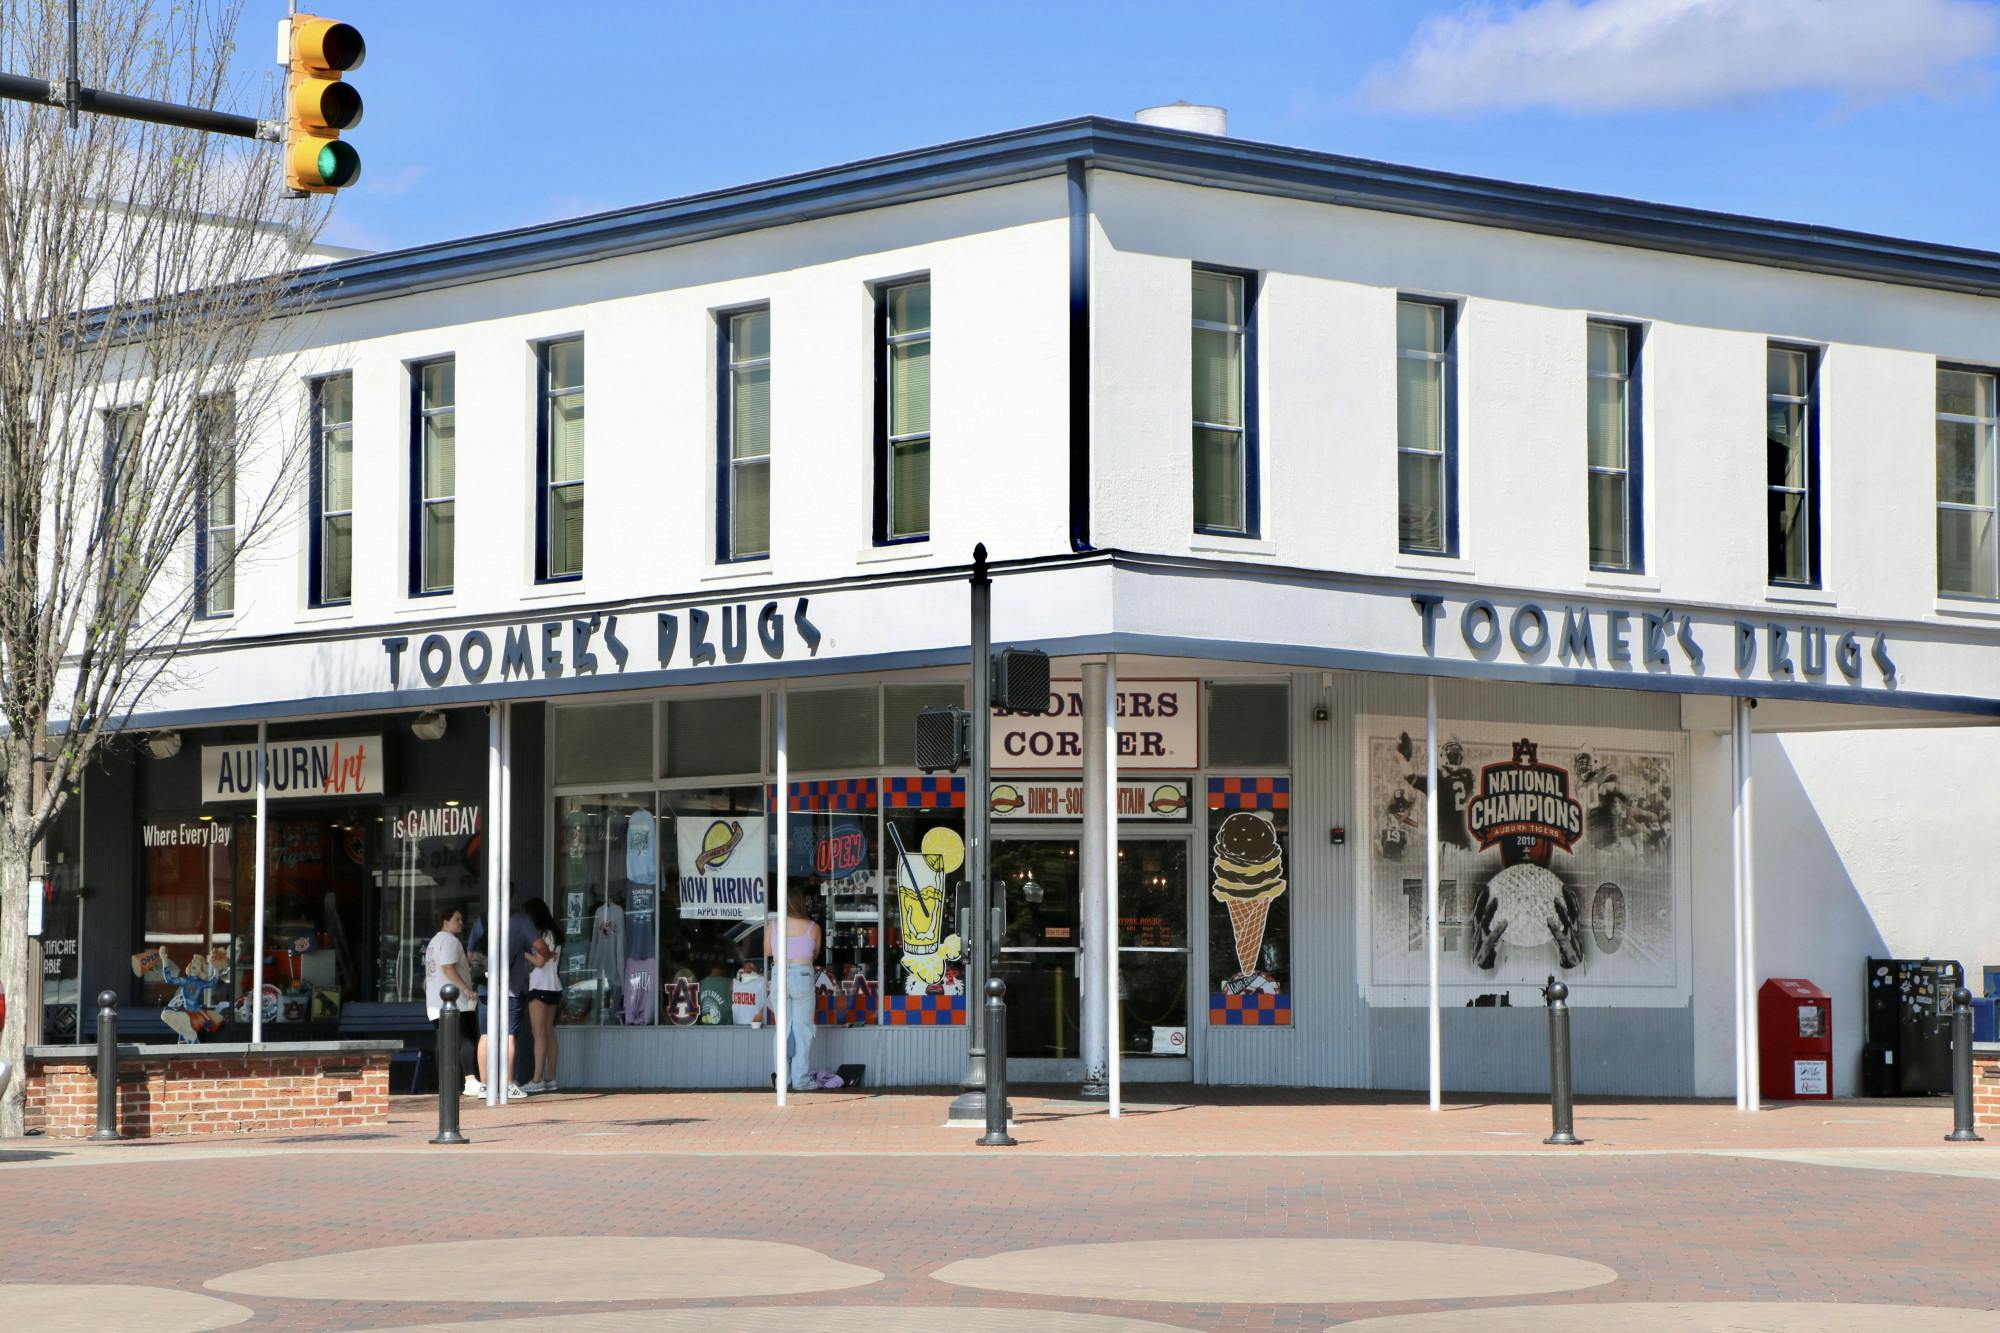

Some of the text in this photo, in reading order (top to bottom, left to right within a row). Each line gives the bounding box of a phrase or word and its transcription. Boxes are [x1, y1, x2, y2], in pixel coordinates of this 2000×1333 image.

[382, 597, 822, 691] TOOMER'S DRUGS
[1410, 592, 1898, 686] TOOMER'S DRUGS
[1004, 731, 1166, 756] CORER
[323, 742, 366, 794] Art
[1453, 781, 1466, 811] 2
[1488, 769, 1563, 798] NATIONAL
[1028, 787, 1084, 815] DINER-SOD
[1471, 793, 1580, 833] CHAMPIONS
[143, 822, 230, 847] Where Every Day
[393, 806, 478, 839] is GAMEDAY
[1386, 830, 1400, 843] 19
[1494, 825, 1559, 838] AUBURN TIGERS
[815, 833, 862, 873] OPEN
[1516, 836, 1536, 846] 2010
[681, 876, 765, 905] NOW HIRING
[697, 907, 743, 917] APPLY INSIDE
[44, 940, 77, 955] TIFICATE
